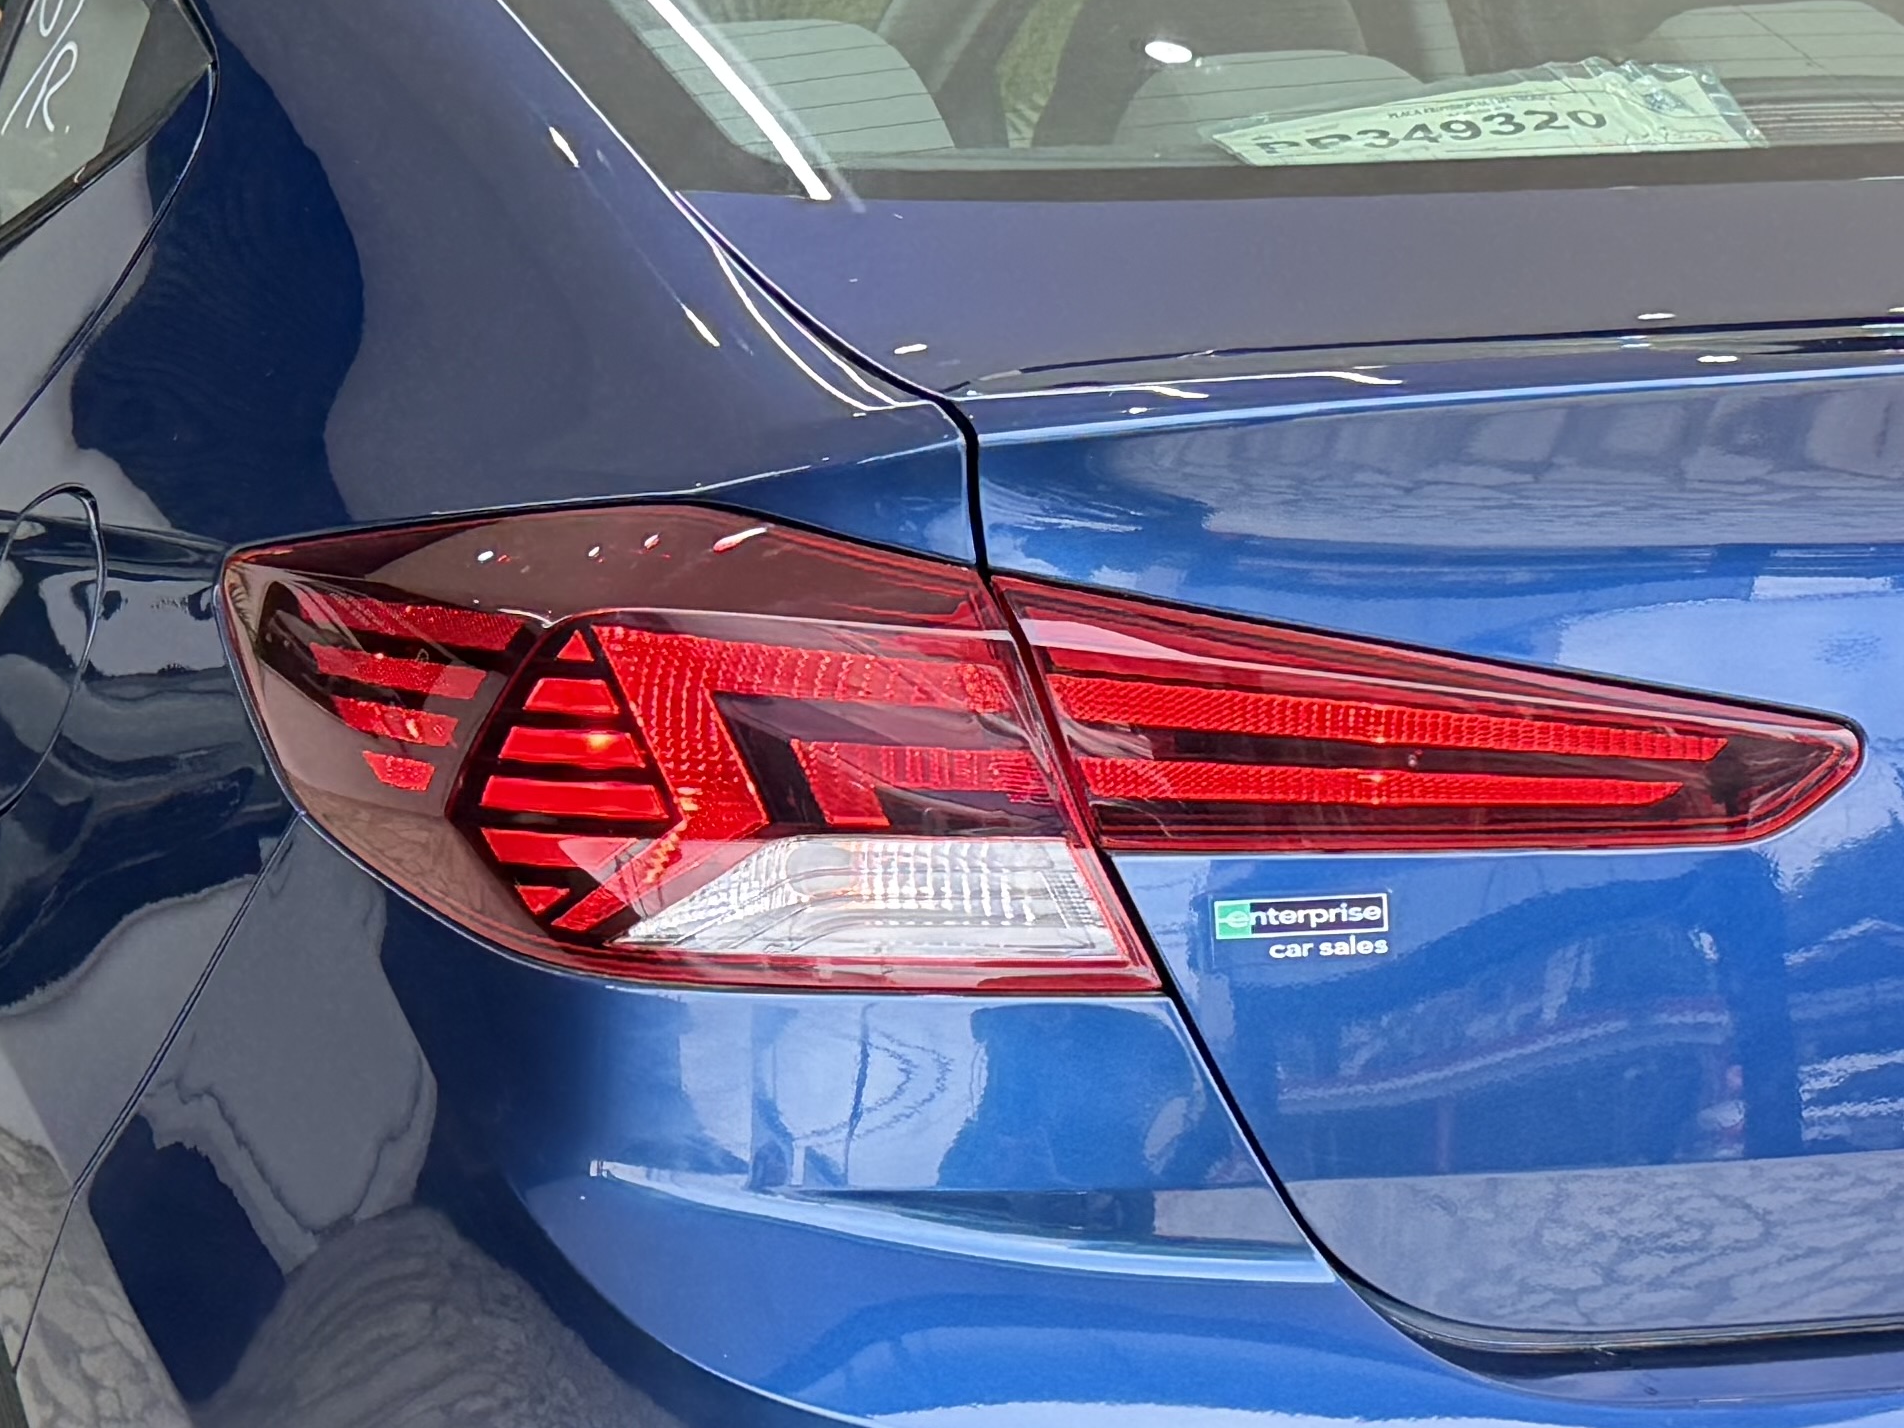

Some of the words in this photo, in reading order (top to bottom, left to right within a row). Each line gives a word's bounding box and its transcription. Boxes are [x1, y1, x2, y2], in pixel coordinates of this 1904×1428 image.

[1223, 902, 1383, 928] enterprise
[1268, 942, 1314, 959] car
[1318, 934, 1389, 956] sales
